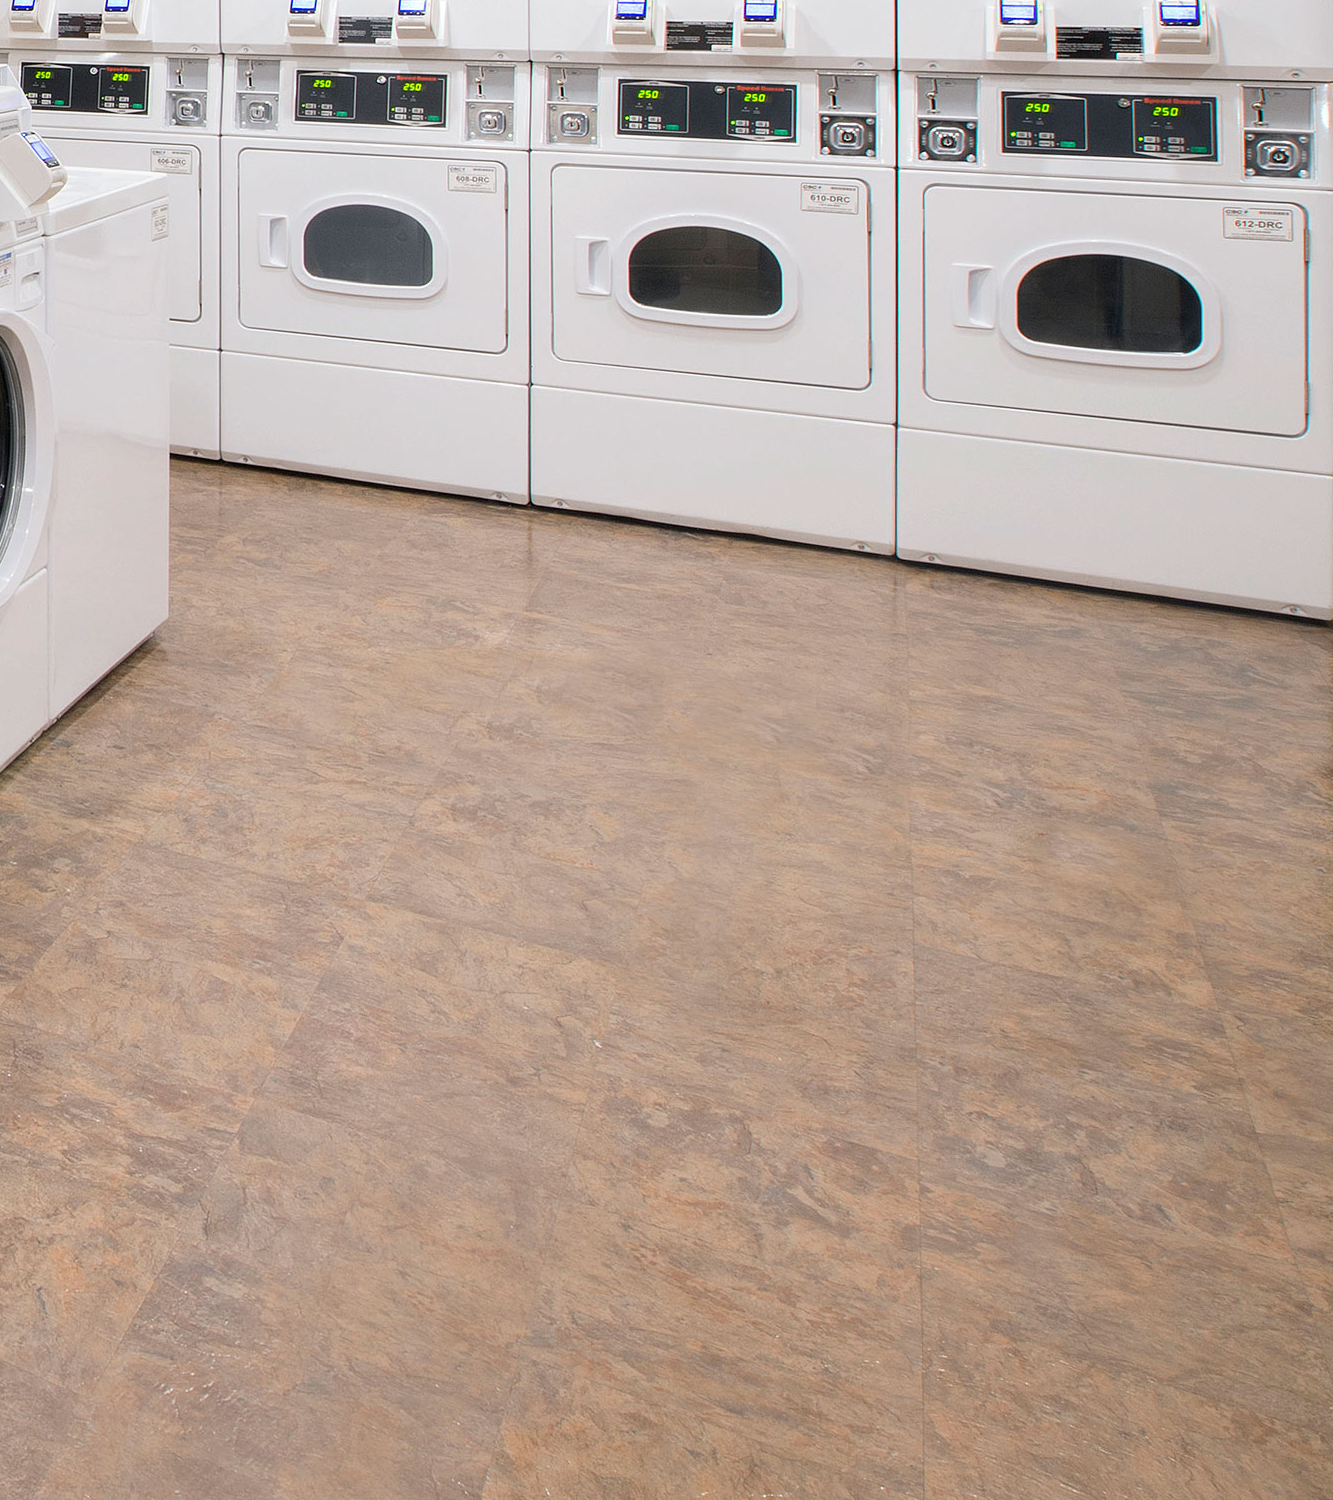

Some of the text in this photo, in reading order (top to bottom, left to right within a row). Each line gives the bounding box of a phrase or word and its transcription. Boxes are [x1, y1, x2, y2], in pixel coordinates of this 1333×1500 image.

[35, 71, 51, 79] 250
[112, 73, 129, 81] 250
[313, 79, 332, 88] 250
[403, 83, 422, 91] 250
[637, 90, 659, 99] 250
[743, 93, 766, 102] 250
[1025, 103, 1051, 113] 250
[1152, 107, 1179, 117] 250
[810, 194, 851, 204] 610-DRC
[1235, 220, 1283, 229] 612-DRC
